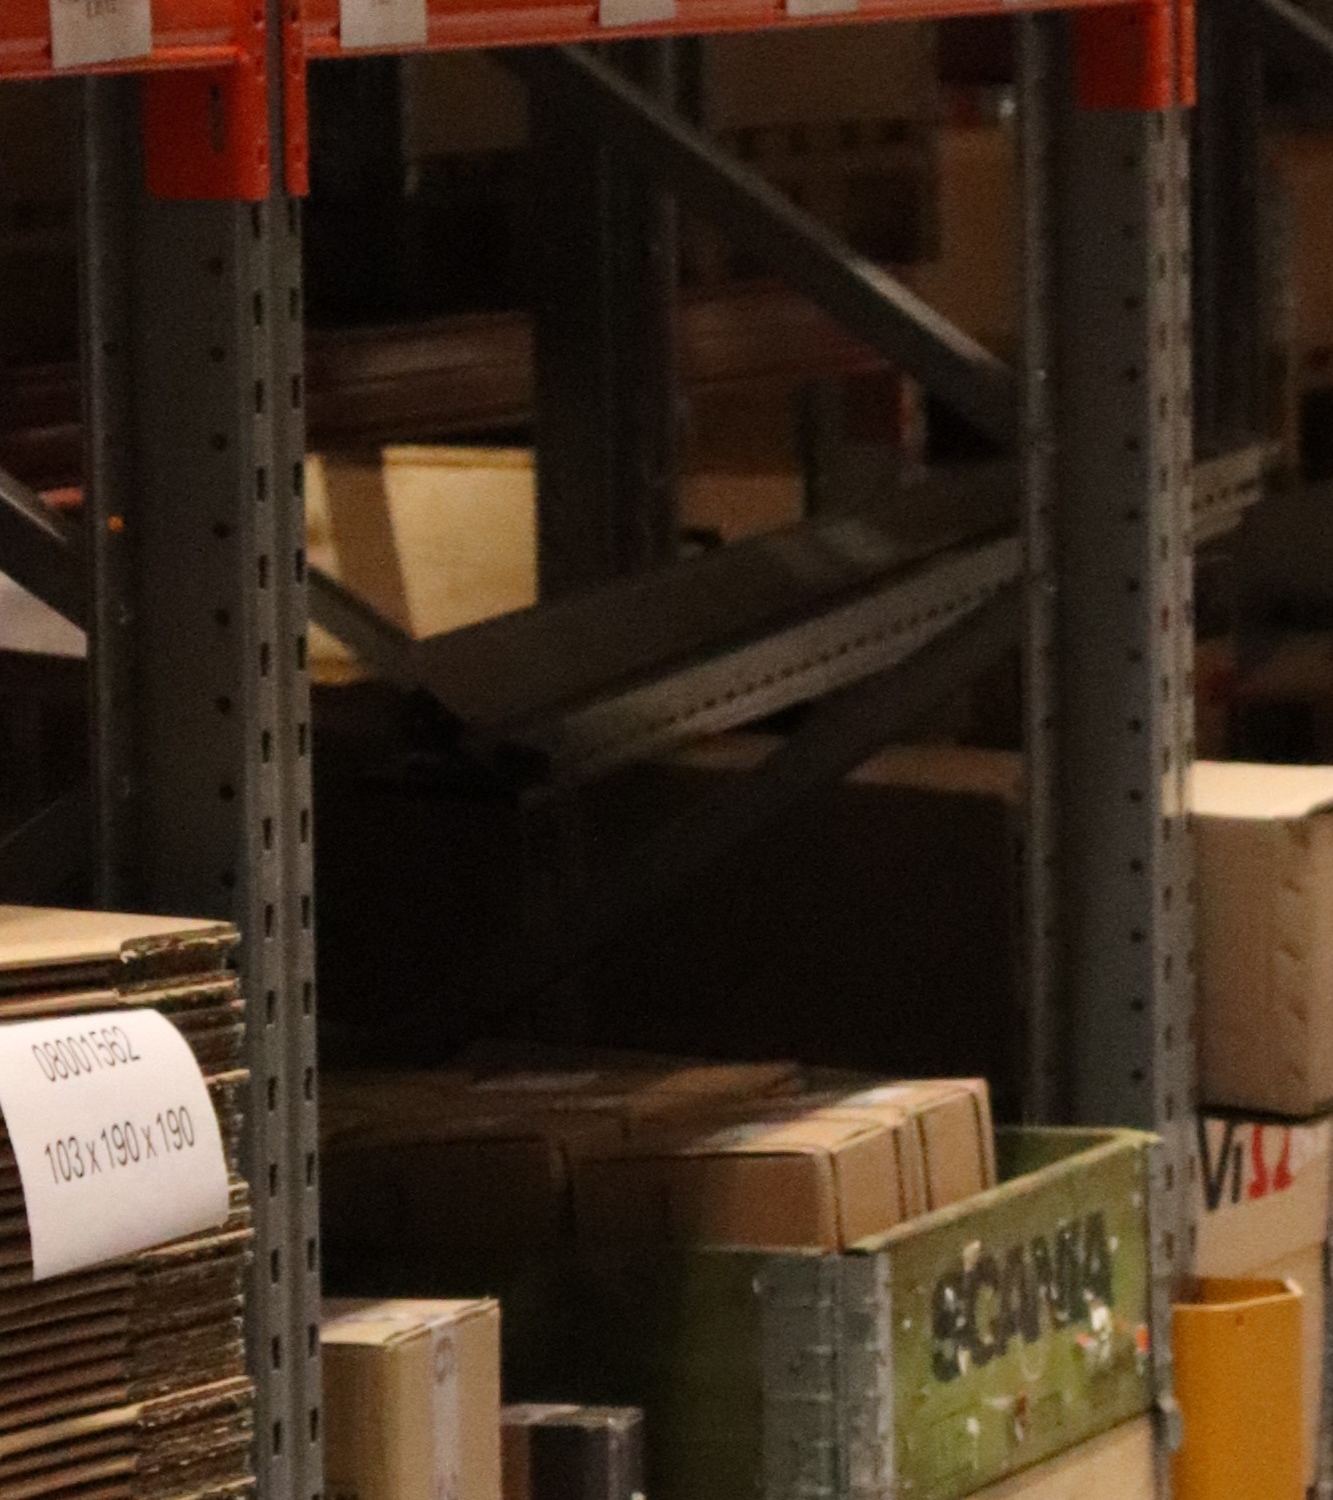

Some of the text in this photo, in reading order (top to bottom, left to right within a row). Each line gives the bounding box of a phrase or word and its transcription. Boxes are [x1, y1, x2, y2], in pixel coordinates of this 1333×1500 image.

[31, 1025, 141, 1082] 08001562
[44, 1135, 84, 1184] 103
[100, 1120, 140, 1169] 190
[156, 1105, 195, 1153] 190
[931, 1211, 1114, 1383] SCANIA
